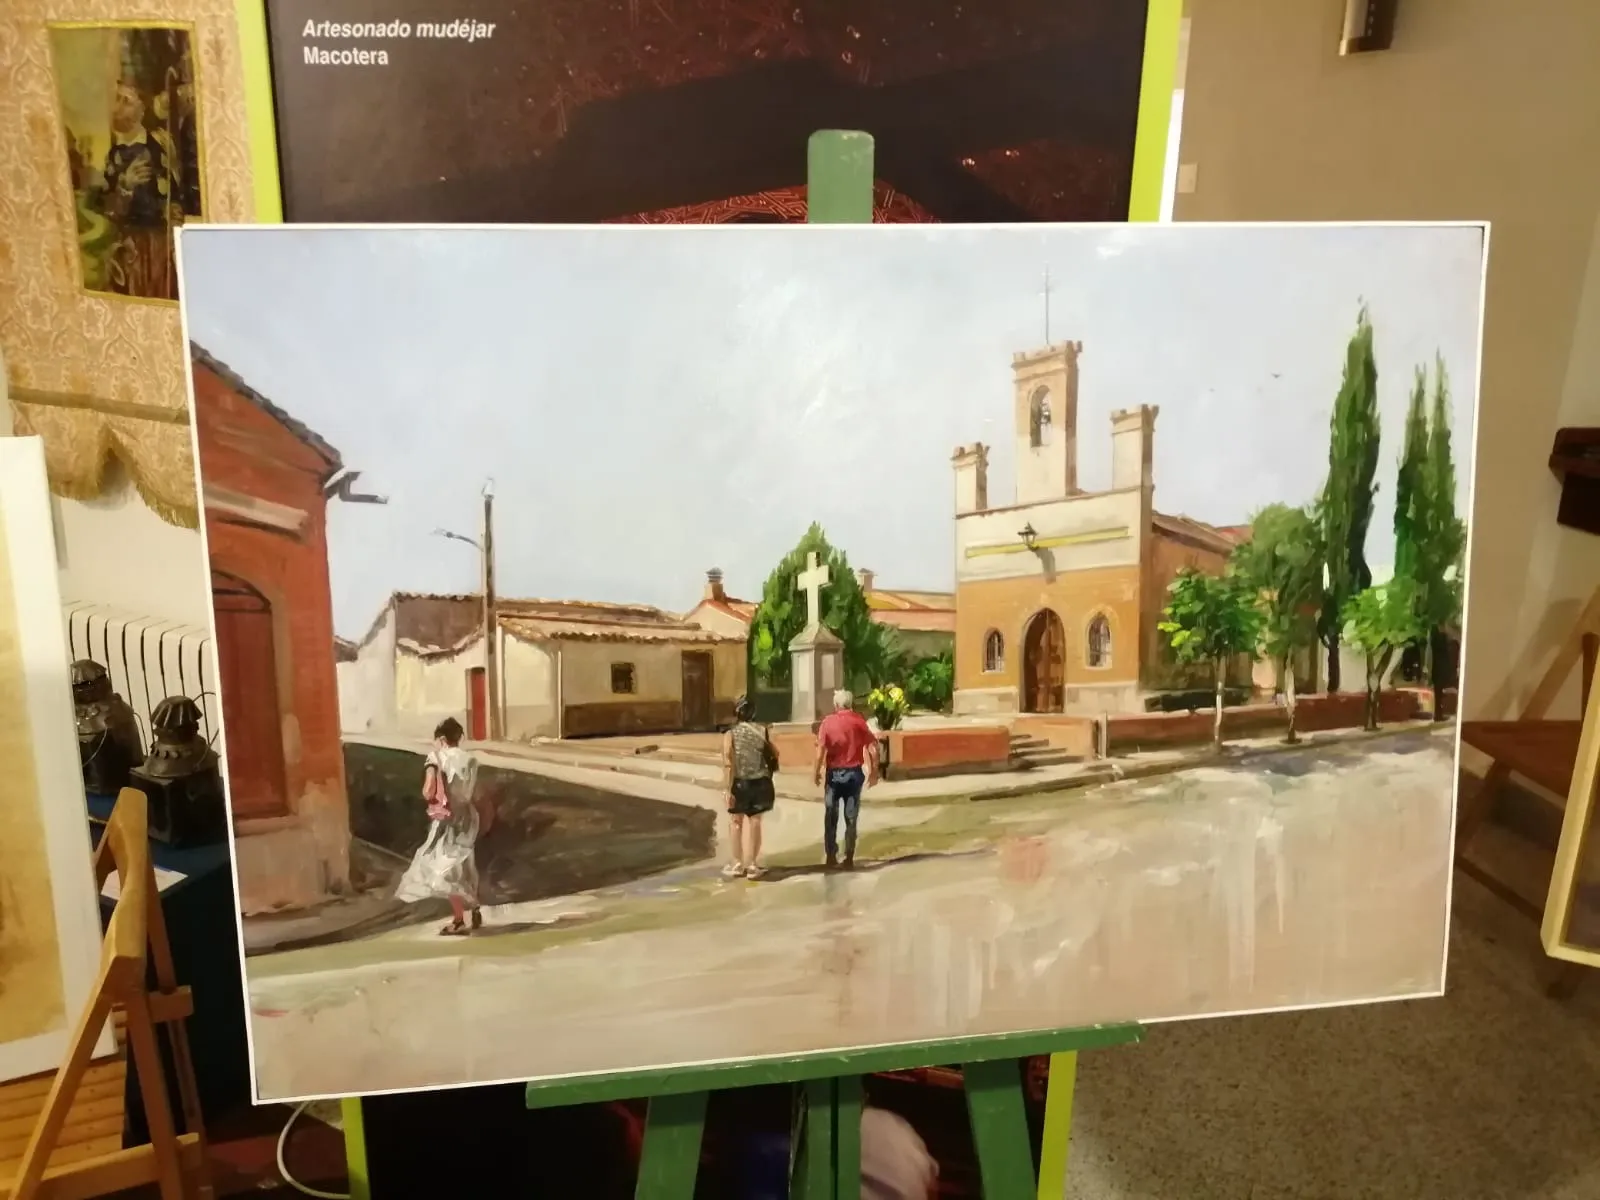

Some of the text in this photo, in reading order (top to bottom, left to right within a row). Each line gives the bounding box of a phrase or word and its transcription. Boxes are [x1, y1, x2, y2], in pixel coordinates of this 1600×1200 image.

[302, 18, 496, 43] Artesonado mudéjar
[303, 46, 389, 65] Macotera
